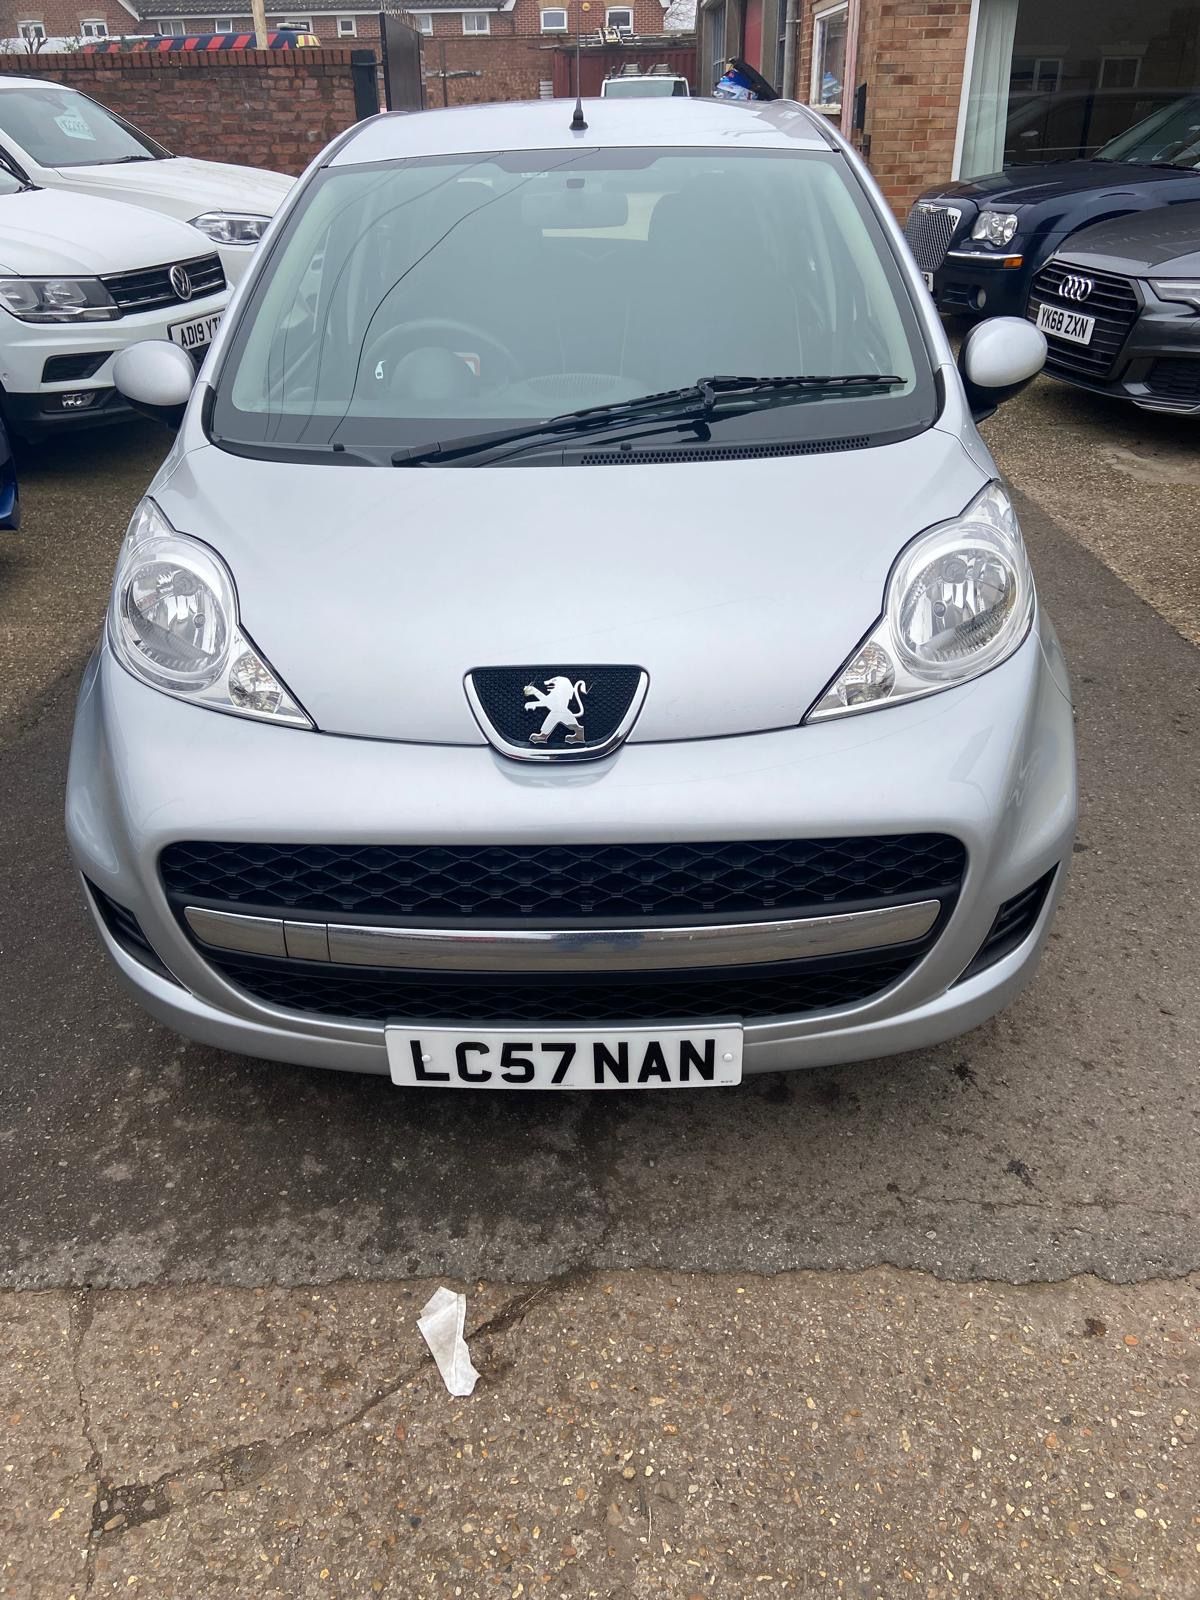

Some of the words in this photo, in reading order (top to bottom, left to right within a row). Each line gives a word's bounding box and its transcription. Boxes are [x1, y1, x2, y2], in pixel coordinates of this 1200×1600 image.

[180, 322, 205, 347] AD19
[1041, 307, 1065, 332] YK68
[1064, 314, 1089, 339] ZXN
[409, 1039, 577, 1084] LC57
[592, 1038, 716, 1084] NAN
